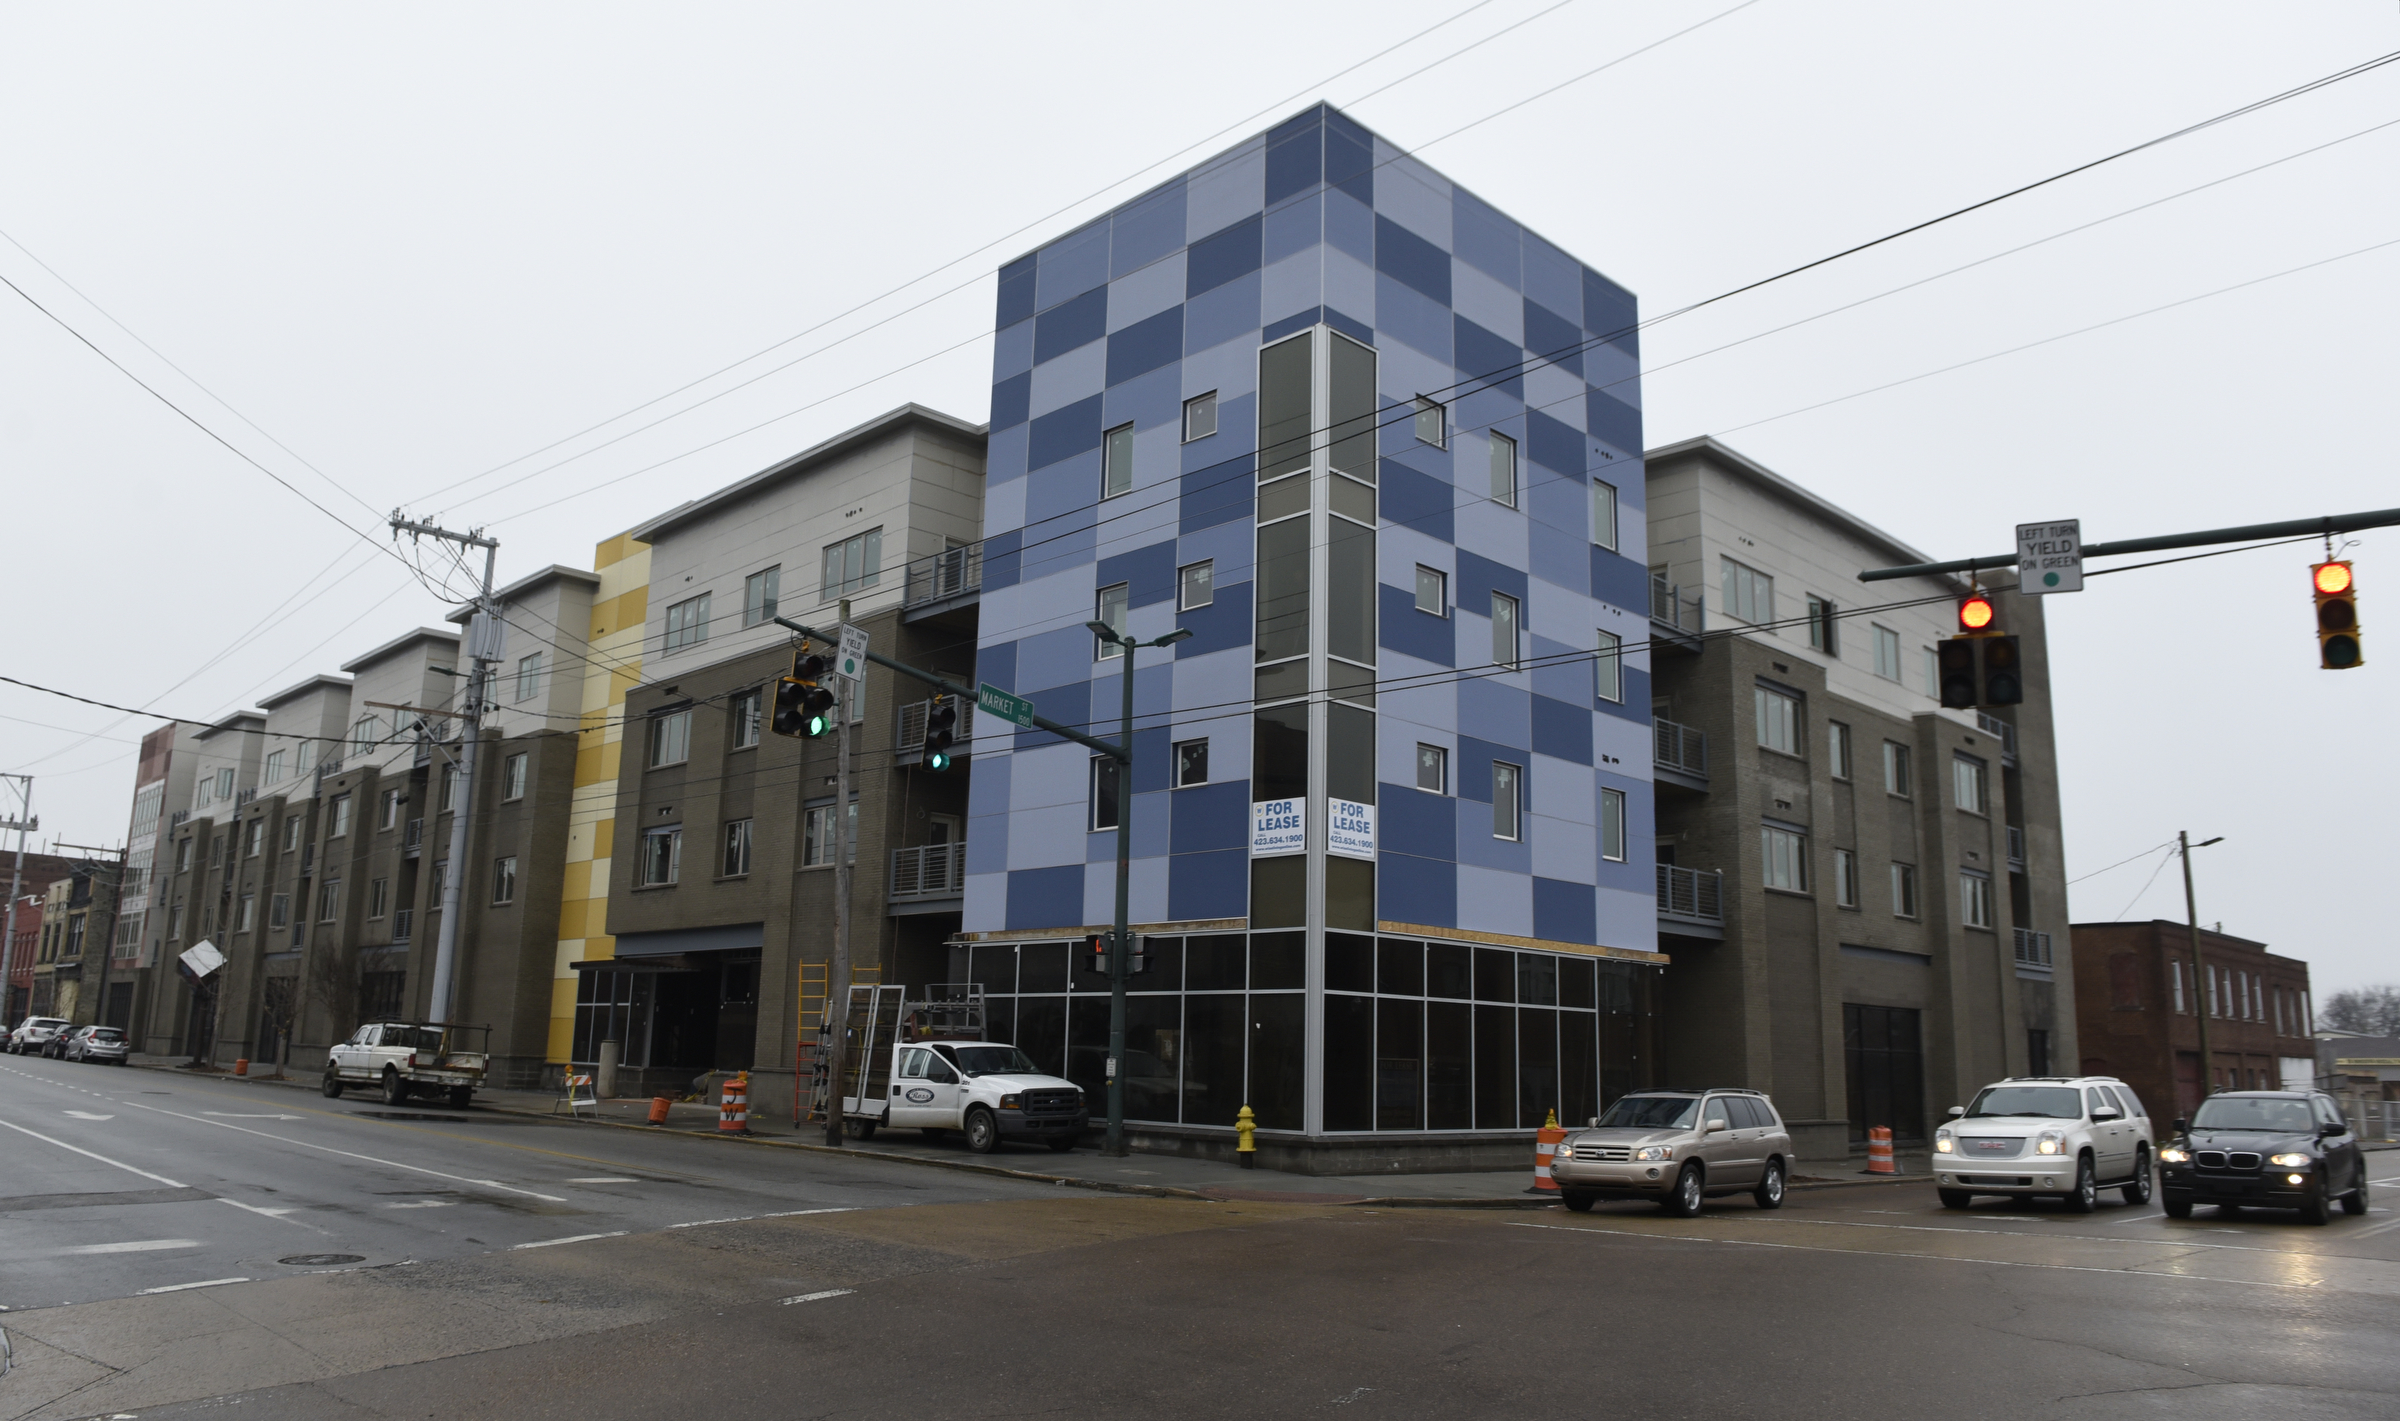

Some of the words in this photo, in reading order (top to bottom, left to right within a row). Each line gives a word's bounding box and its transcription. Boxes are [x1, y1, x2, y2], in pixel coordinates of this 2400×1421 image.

[2020, 527, 2044, 540] LEFT
[2049, 524, 2077, 537] TURN
[2026, 539, 2072, 556] YIELD
[2022, 559, 2037, 571] ON
[2042, 556, 2078, 568] GREEN
[843, 626, 854, 636] LEFT
[856, 631, 867, 641] TURN
[846, 638, 861, 650] YIELD
[849, 649, 862, 660] GREEN
[981, 690, 1014, 715] MARKET
[1021, 702, 1028, 712] ST
[1017, 714, 1030, 726] 1500
[1266, 801, 1292, 816] FOR
[1341, 802, 1364, 818] FOR
[1258, 815, 1299, 831] LEASE
[1334, 816, 1370, 834] LEASE
[1254, 834, 1303, 845] 423.634.1900
[1330, 835, 1373, 848] 423.634.1900
[725, 1108, 738, 1121] W
